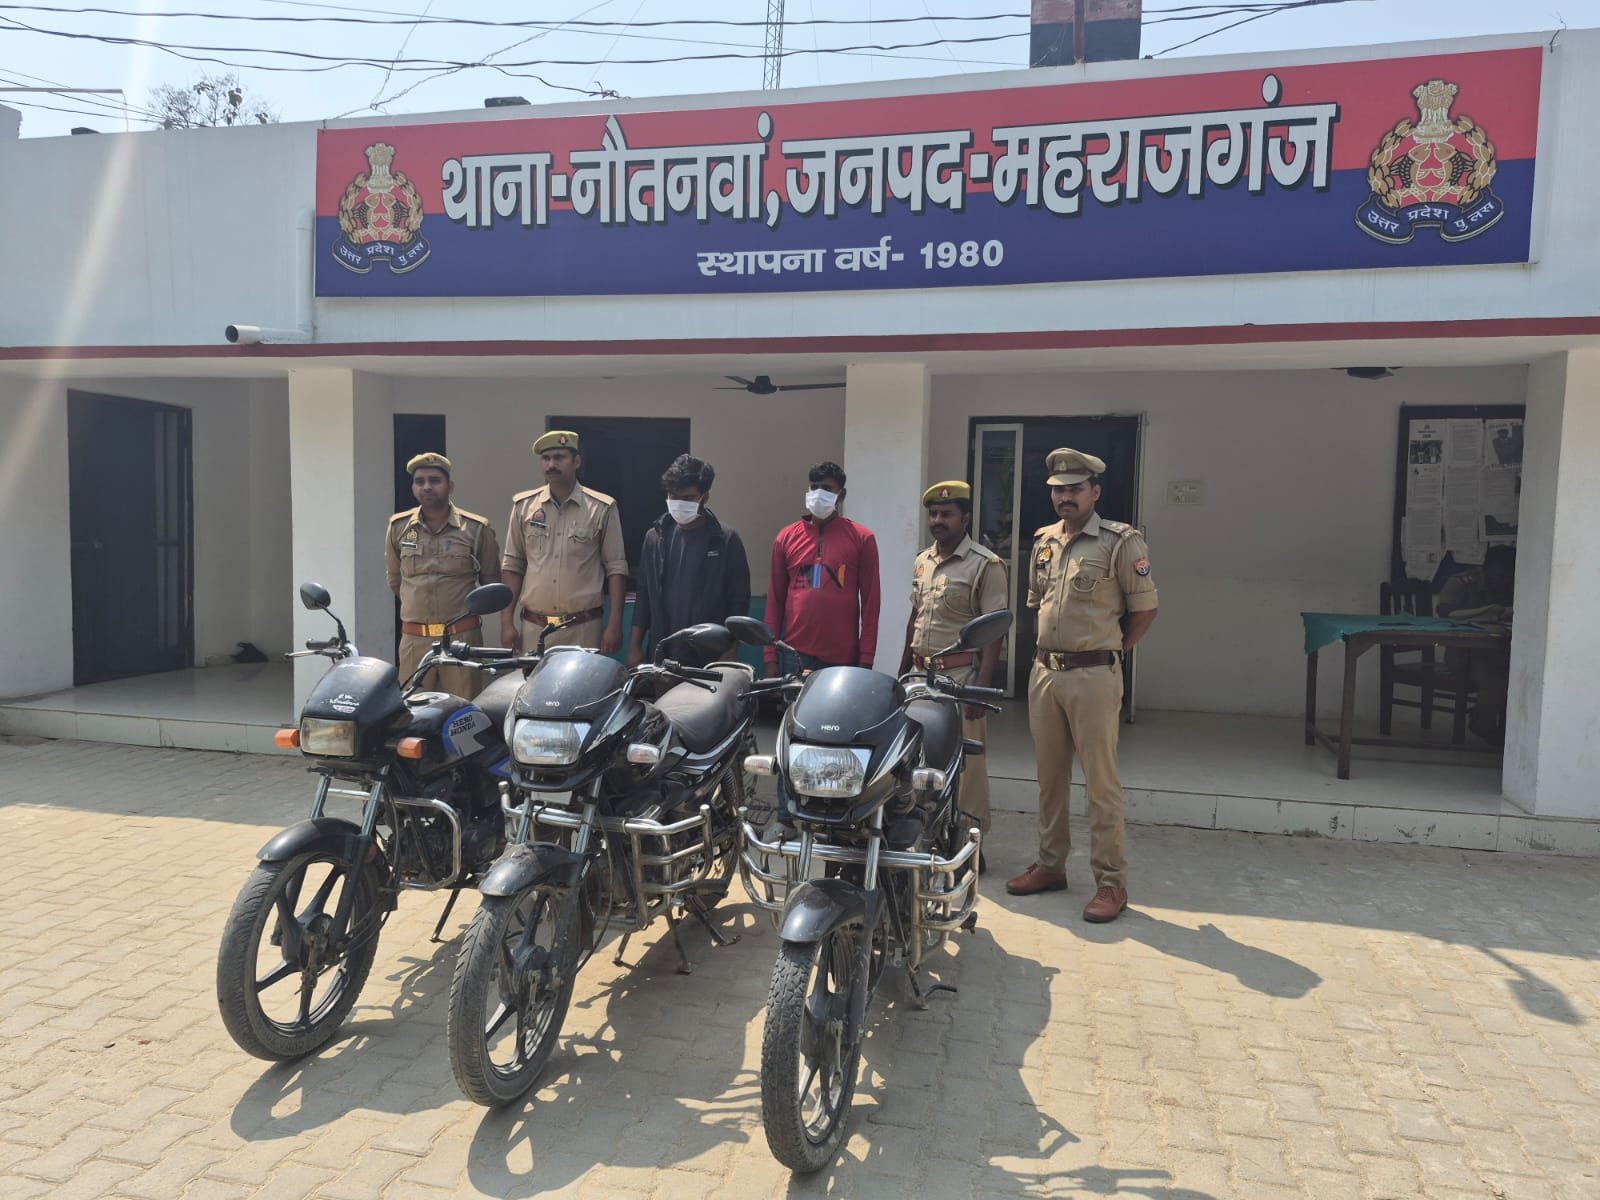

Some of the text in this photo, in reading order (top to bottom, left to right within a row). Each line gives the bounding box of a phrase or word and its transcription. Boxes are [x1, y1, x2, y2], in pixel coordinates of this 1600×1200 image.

[1368, 210, 1399, 233] उत्तर
[1407, 204, 1449, 220] प्रदेश
[366, 242, 395, 256] प्रदेश
[697, 248, 827, 276] स्थापना
[920, 239, 1004, 270] 1980
[450, 720, 477, 737] HONDA
[453, 714, 473, 728] HERO
